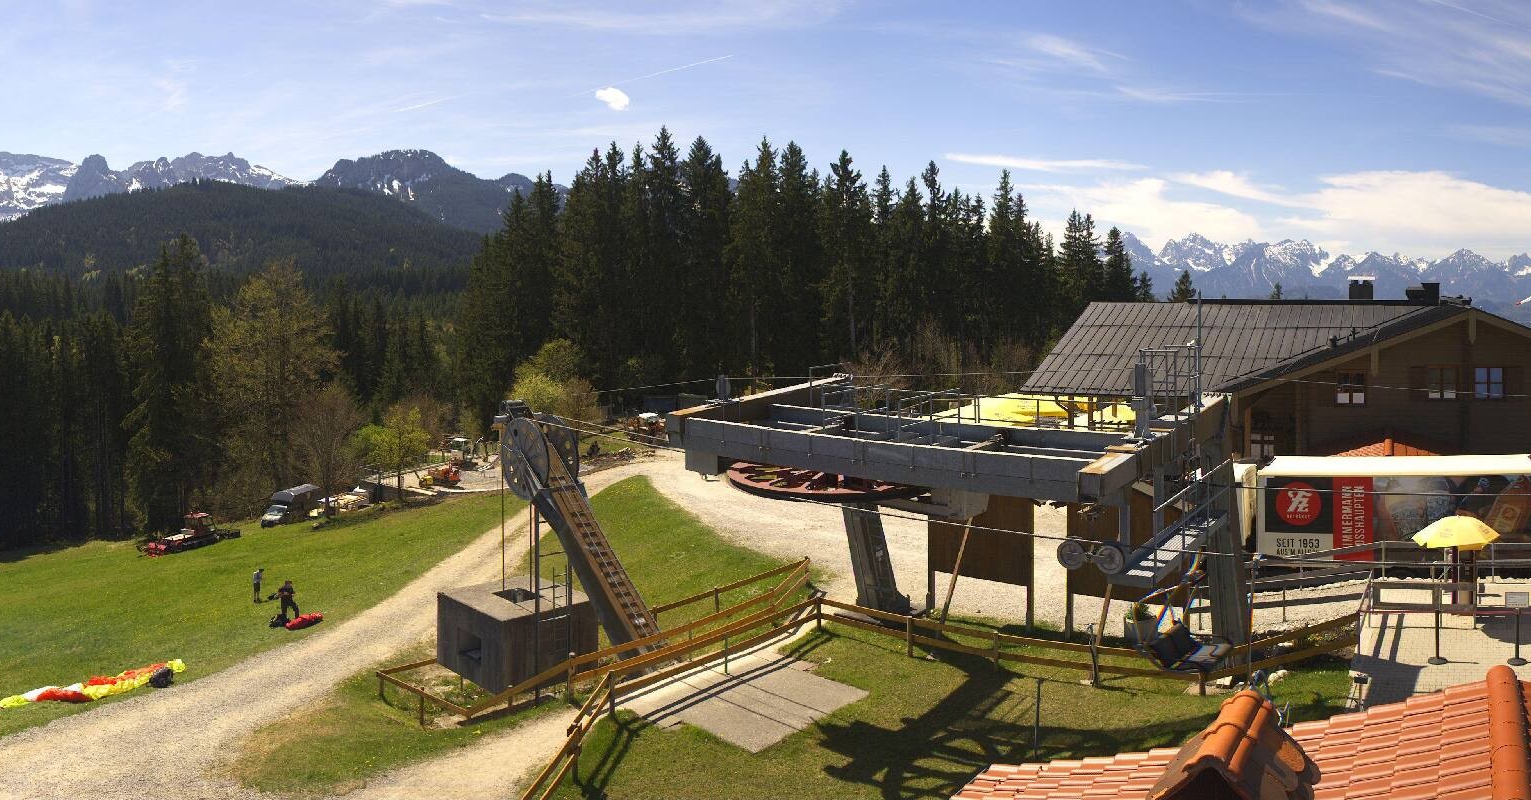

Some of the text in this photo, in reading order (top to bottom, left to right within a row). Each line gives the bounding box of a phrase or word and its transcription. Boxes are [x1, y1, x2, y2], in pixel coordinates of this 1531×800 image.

[1276, 538, 1320, 549] SEIT 1953
[1341, 485, 1353, 548] IMMERMANN
[1354, 485, 1365, 547] OSSHAUPTEN
